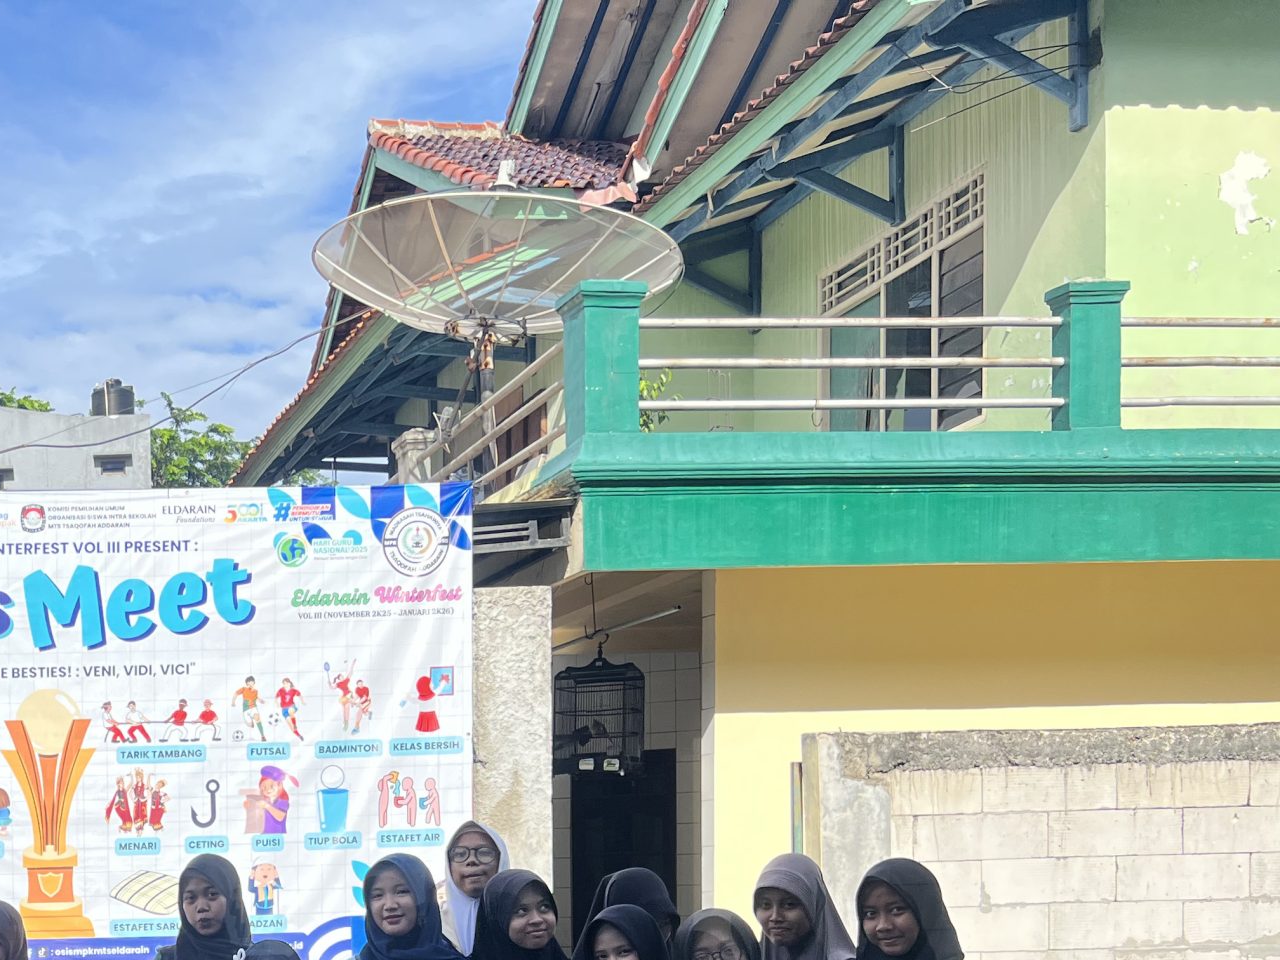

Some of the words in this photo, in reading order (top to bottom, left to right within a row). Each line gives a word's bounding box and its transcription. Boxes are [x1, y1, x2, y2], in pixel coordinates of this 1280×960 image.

[162, 504, 216, 514] ELDARAIN
[175, 515, 216, 523] Foundations
[73, 542, 104, 554] VOL
[107, 541, 120, 553] III
[124, 540, 191, 553] PRESENT
[290, 588, 370, 608] Eldarain
[374, 584, 464, 604] Winterfest
[23, 557, 257, 653] Meet
[324, 610, 371, 620] (NOVEMBER
[12, 664, 72, 680] BESTIES!
[82, 665, 120, 681] VENI,
[123, 663, 158, 679] VIDI,
[318, 743, 380, 755] BADMINTON
[392, 742, 423, 752] KELAS
[424, 740, 461, 751] BERSIH
[119, 750, 151, 760] TARIK
[151, 749, 204, 759] TAMBANG
[250, 747, 288, 757] FUTSAL
[255, 838, 281, 848] PUISI
[308, 837, 330, 846] TIUP
[331, 835, 359, 846] BOLA
[380, 833, 421, 844] ESTAFET
[423, 832, 441, 842] AIR
[119, 841, 158, 851] MENARI
[188, 840, 225, 850] CETING
[113, 922, 155, 932] ESTAFET
